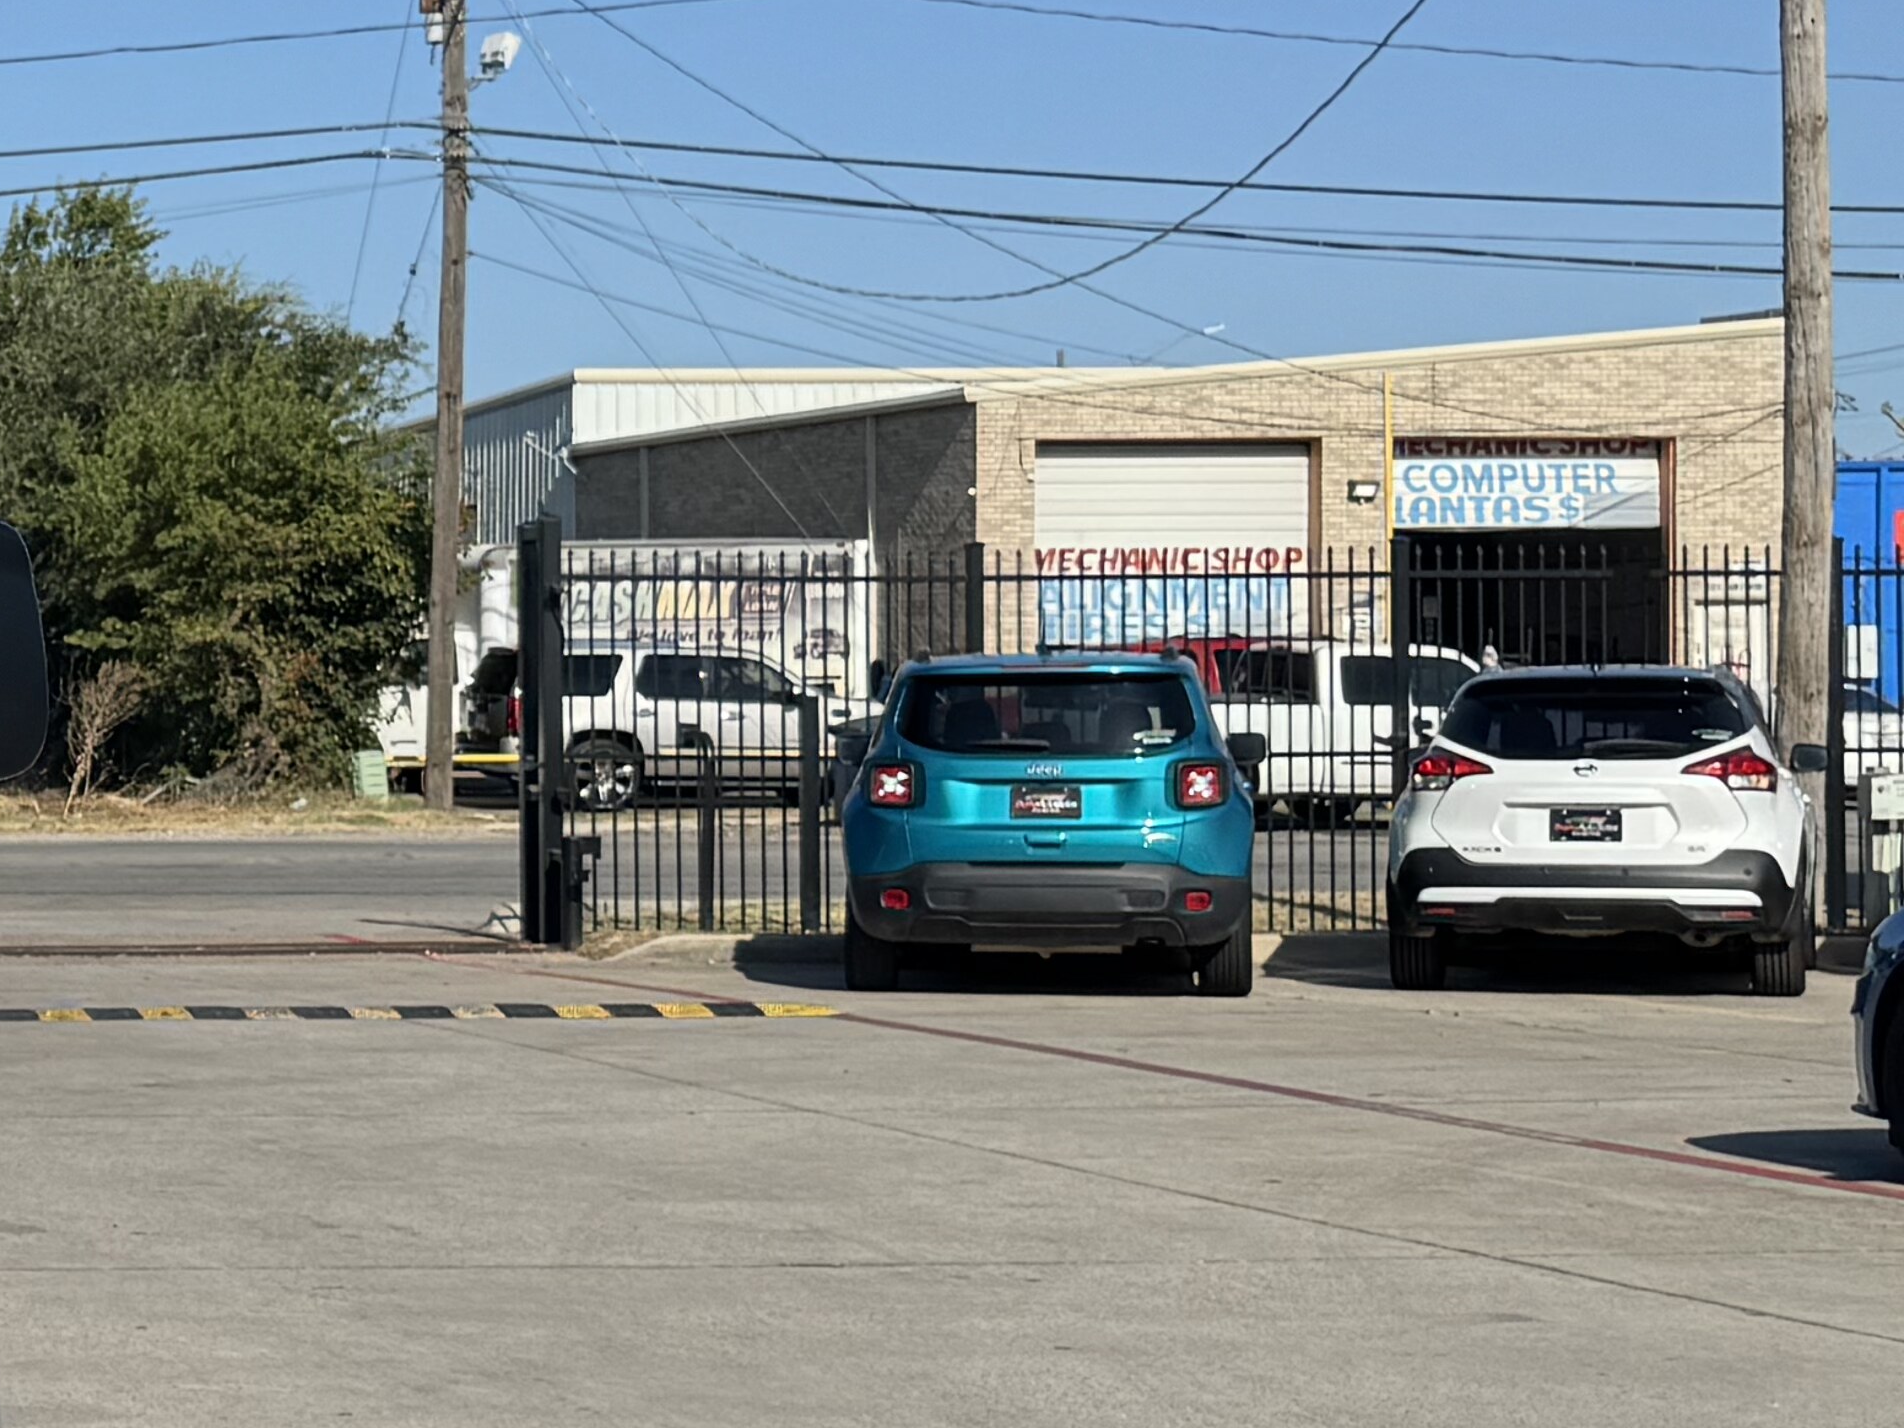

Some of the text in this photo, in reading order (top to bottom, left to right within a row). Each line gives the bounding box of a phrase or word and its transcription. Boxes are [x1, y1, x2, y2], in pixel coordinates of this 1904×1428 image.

[1558, 439, 1648, 456] SHOP
[1402, 463, 1619, 494] COMPUTER
[1210, 547, 1303, 571] SHOP
